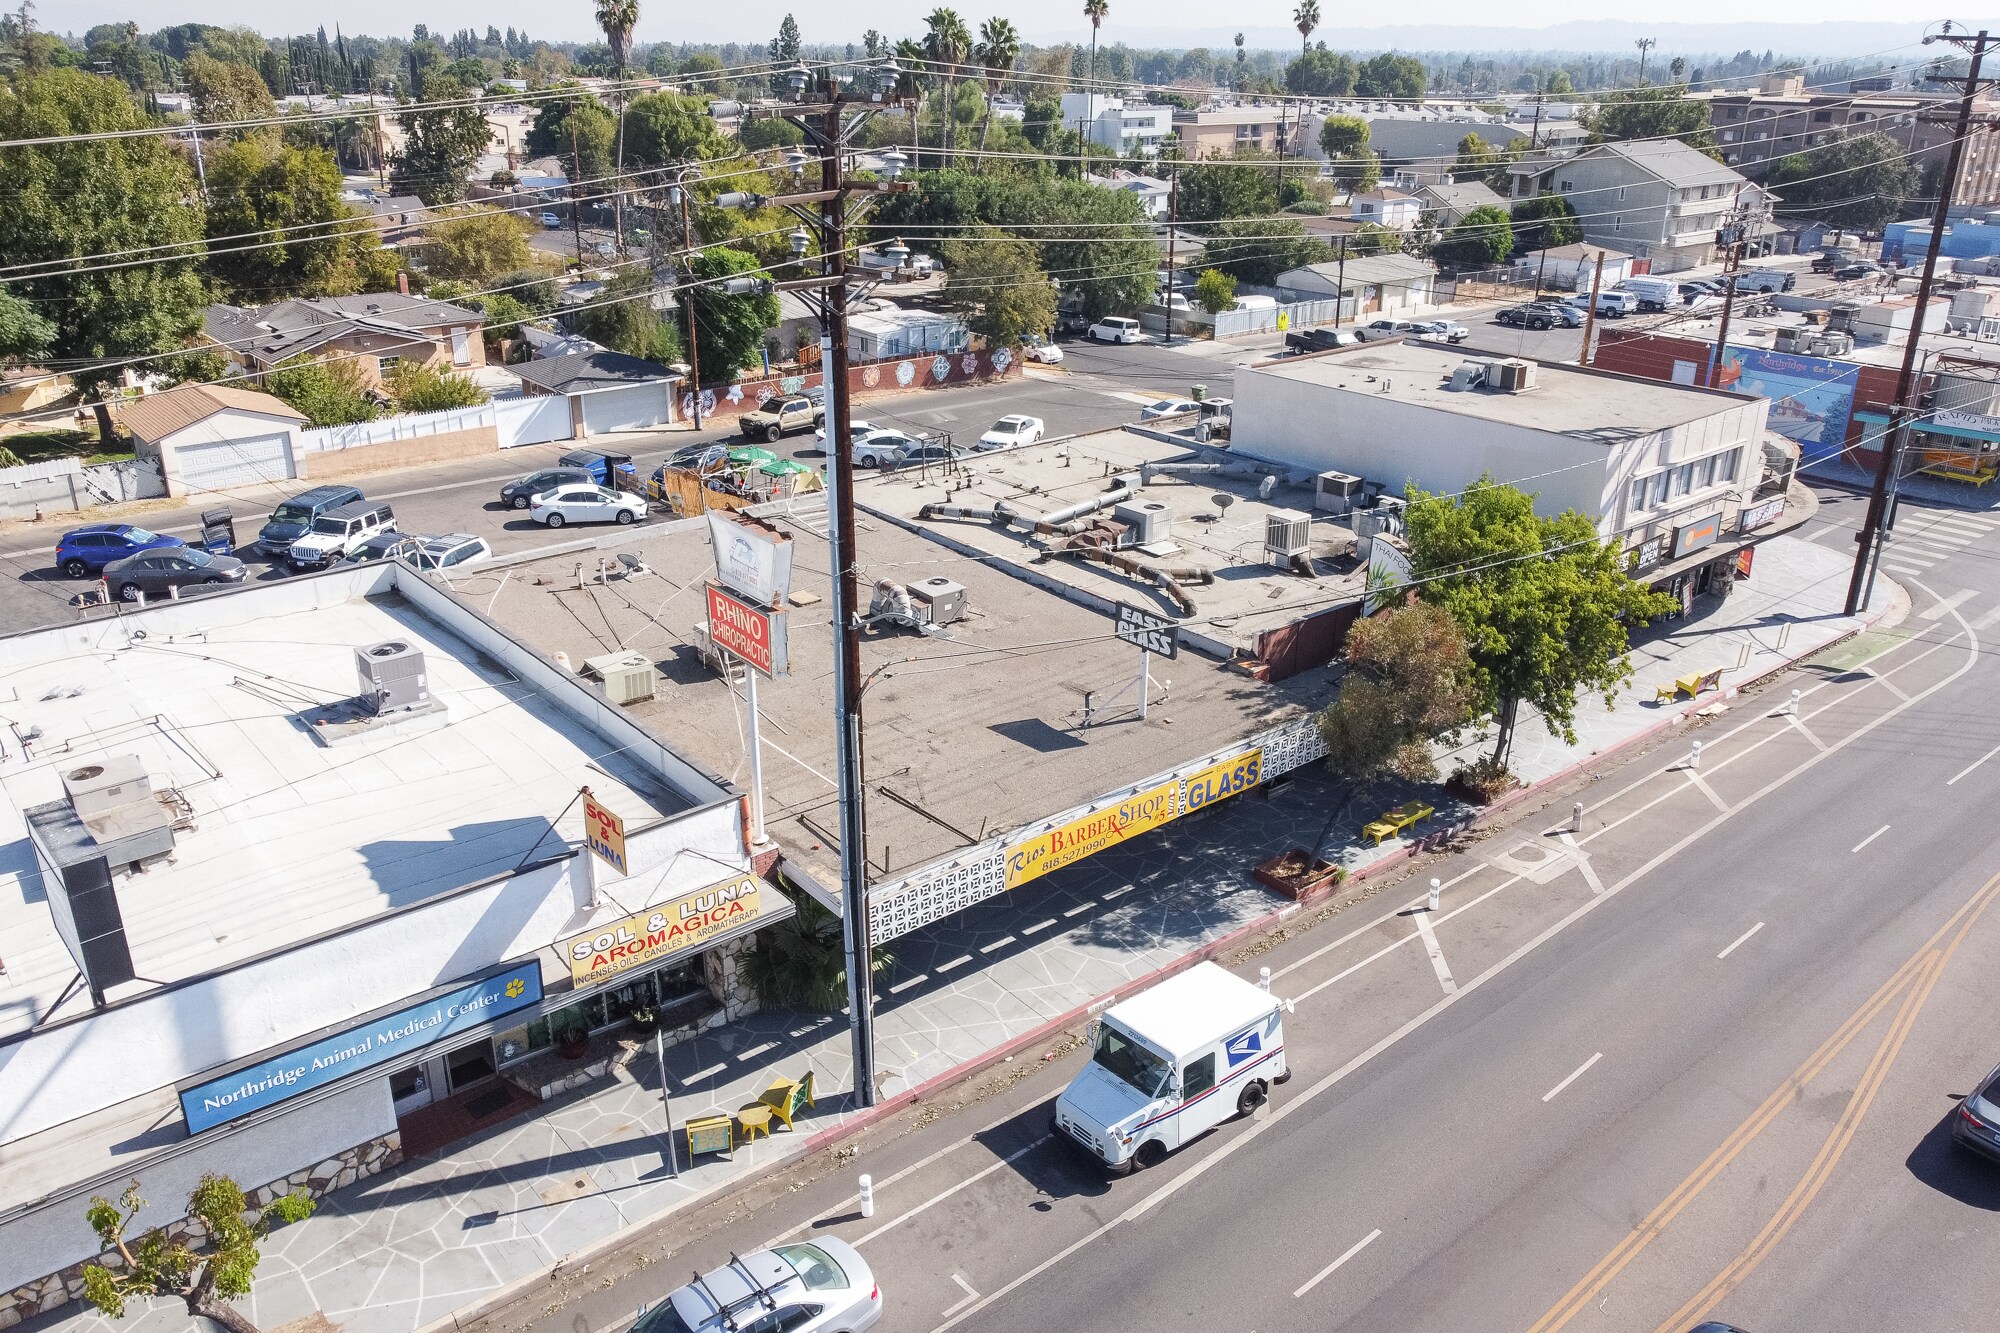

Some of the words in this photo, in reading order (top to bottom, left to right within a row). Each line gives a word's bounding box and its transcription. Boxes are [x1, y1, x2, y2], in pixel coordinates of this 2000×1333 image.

[1758, 356, 1808, 371] Northridge
[1375, 543, 1394, 559] THAI
[1640, 548, 1659, 565] OPEN
[1642, 539, 1659, 554] NOW
[715, 596, 762, 640] RHINO
[1121, 606, 1168, 633] EASY
[712, 617, 770, 667] CHIROPRACTIC
[1117, 620, 1172, 655] GLASS
[1216, 760, 1236, 772] EASY
[1188, 760, 1259, 809] GLASS
[586, 803, 621, 837] SOL
[600, 827, 610, 842] &
[588, 834, 624, 868] LUNA
[1008, 844, 1046, 881] Rios
[1042, 837, 1106, 872] 818.527.1990
[572, 926, 636, 961] SOL
[646, 912, 670, 933] &
[680, 878, 758, 920] LUNA
[591, 901, 744, 971] AROMAGICA
[575, 962, 618, 987] INCENSES
[644, 938, 682, 959] CANDLES
[686, 933, 692, 942] &
[696, 907, 759, 938] AROMATHERAPY
[204, 1064, 306, 1112] Northridge
[311, 1038, 373, 1073] Animal
[377, 1009, 442, 1046] Medical
[447, 990, 501, 1019] Center
